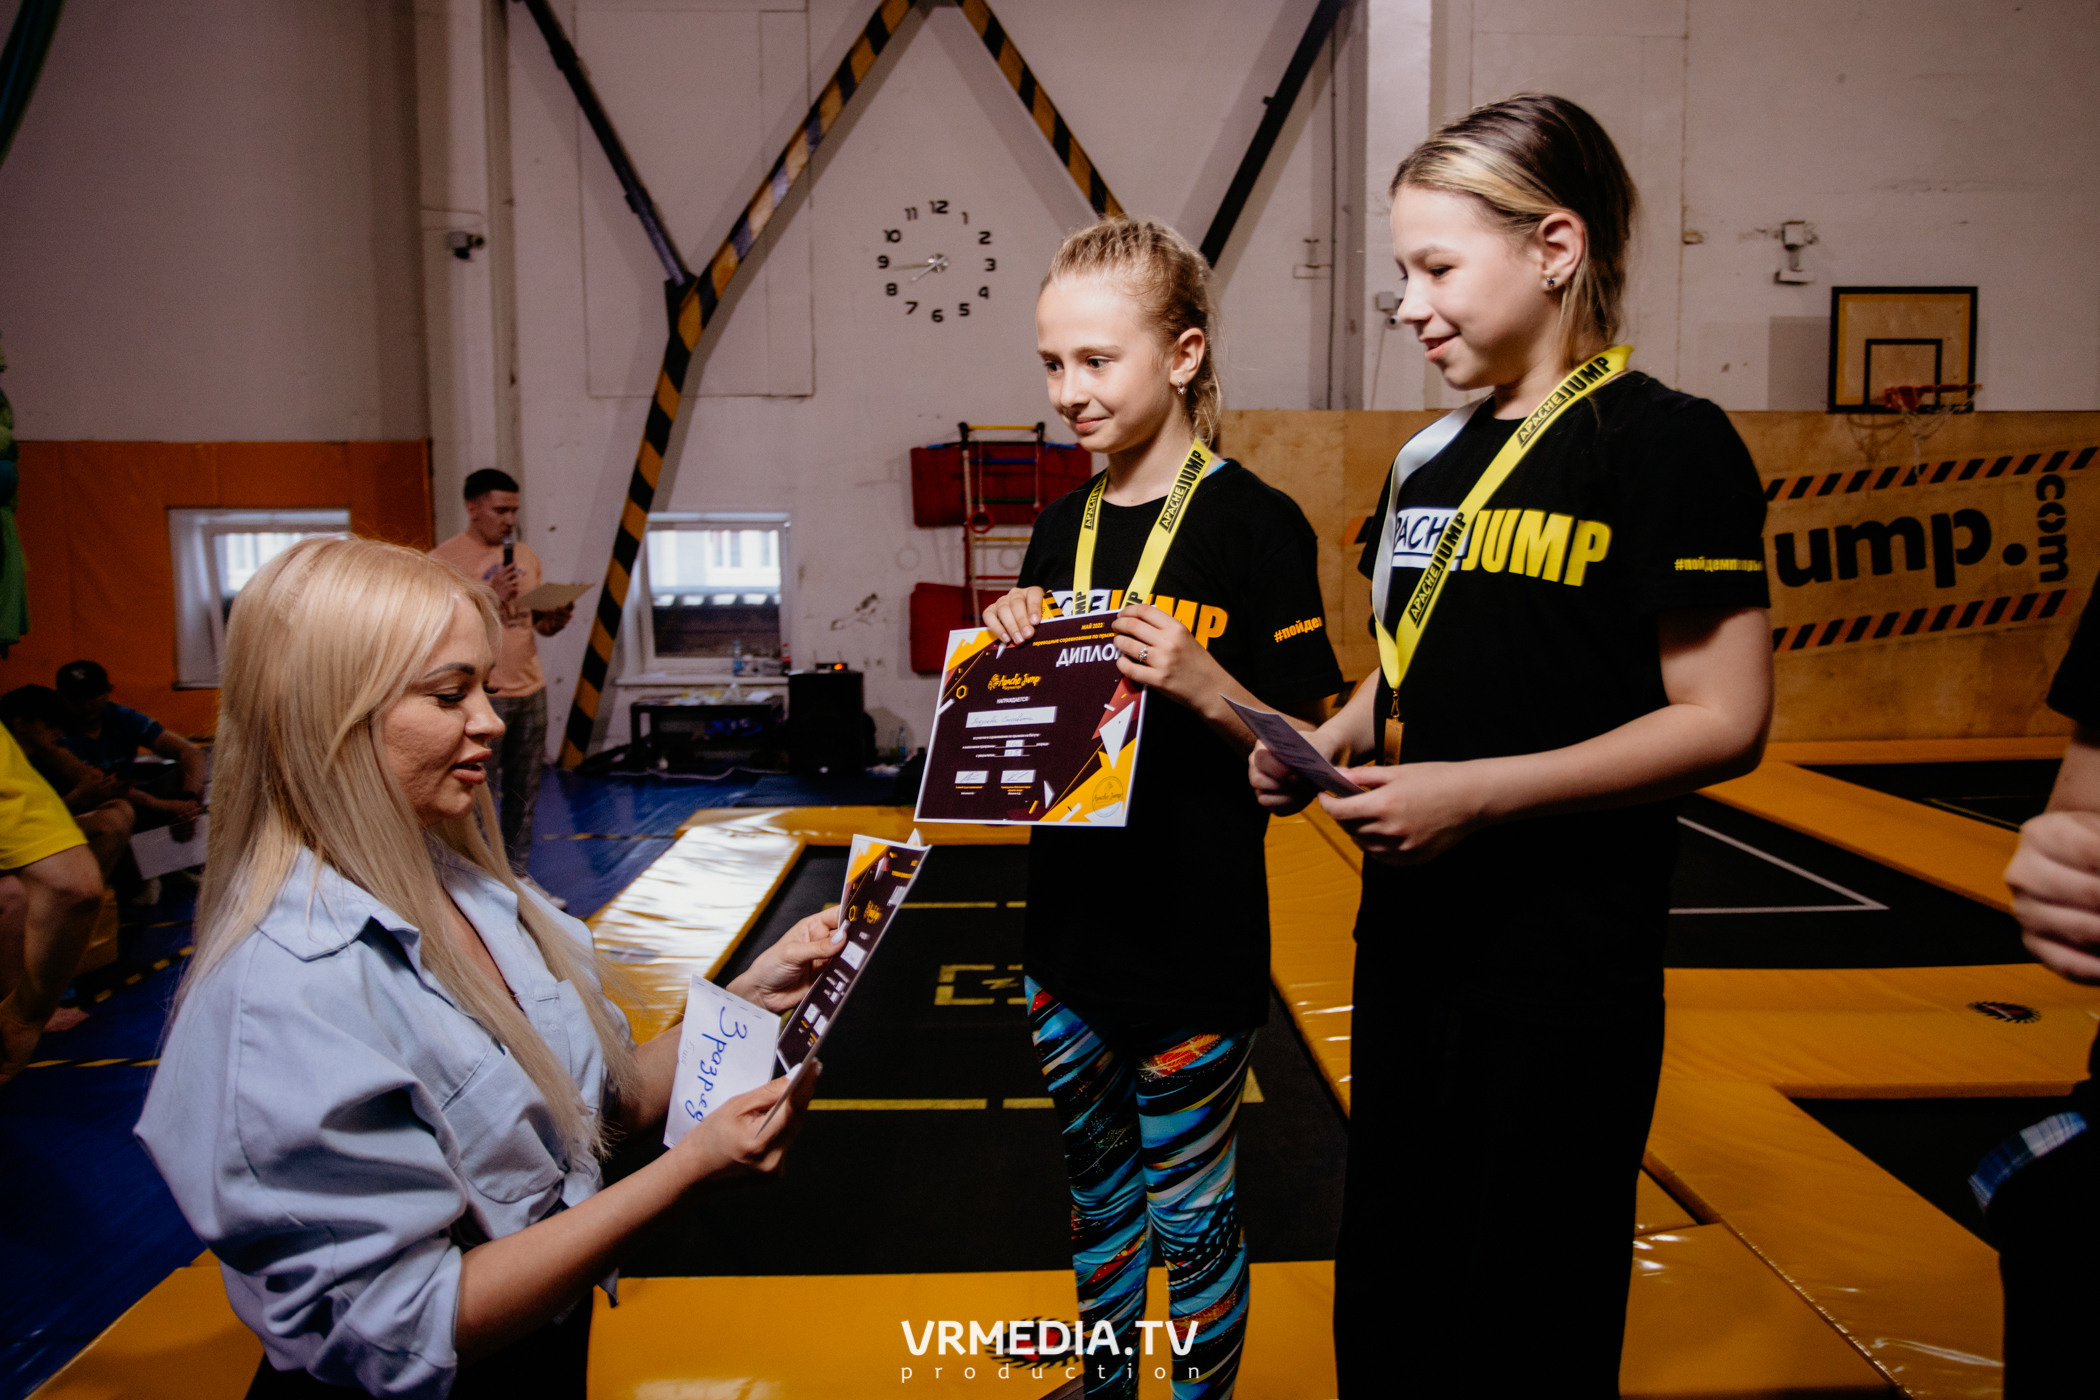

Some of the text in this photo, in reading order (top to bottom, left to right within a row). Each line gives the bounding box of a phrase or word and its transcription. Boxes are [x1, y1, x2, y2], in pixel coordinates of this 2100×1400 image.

[905, 207, 918, 221] 11
[929, 200, 949, 215] 12
[962, 211, 969, 225] 1
[884, 229, 902, 243] 10
[978, 231, 992, 245] 2
[877, 255, 890, 269] 9
[985, 258, 997, 272] 3
[886, 283, 898, 297] 8
[978, 286, 990, 300] 4
[905, 302, 919, 315] 7
[958, 303, 971, 317] 5
[931, 309, 944, 323] 6
[2035, 473, 2070, 584] com
[1394, 508, 1613, 587] PACH JUMP
[1775, 508, 2028, 589] ump.
